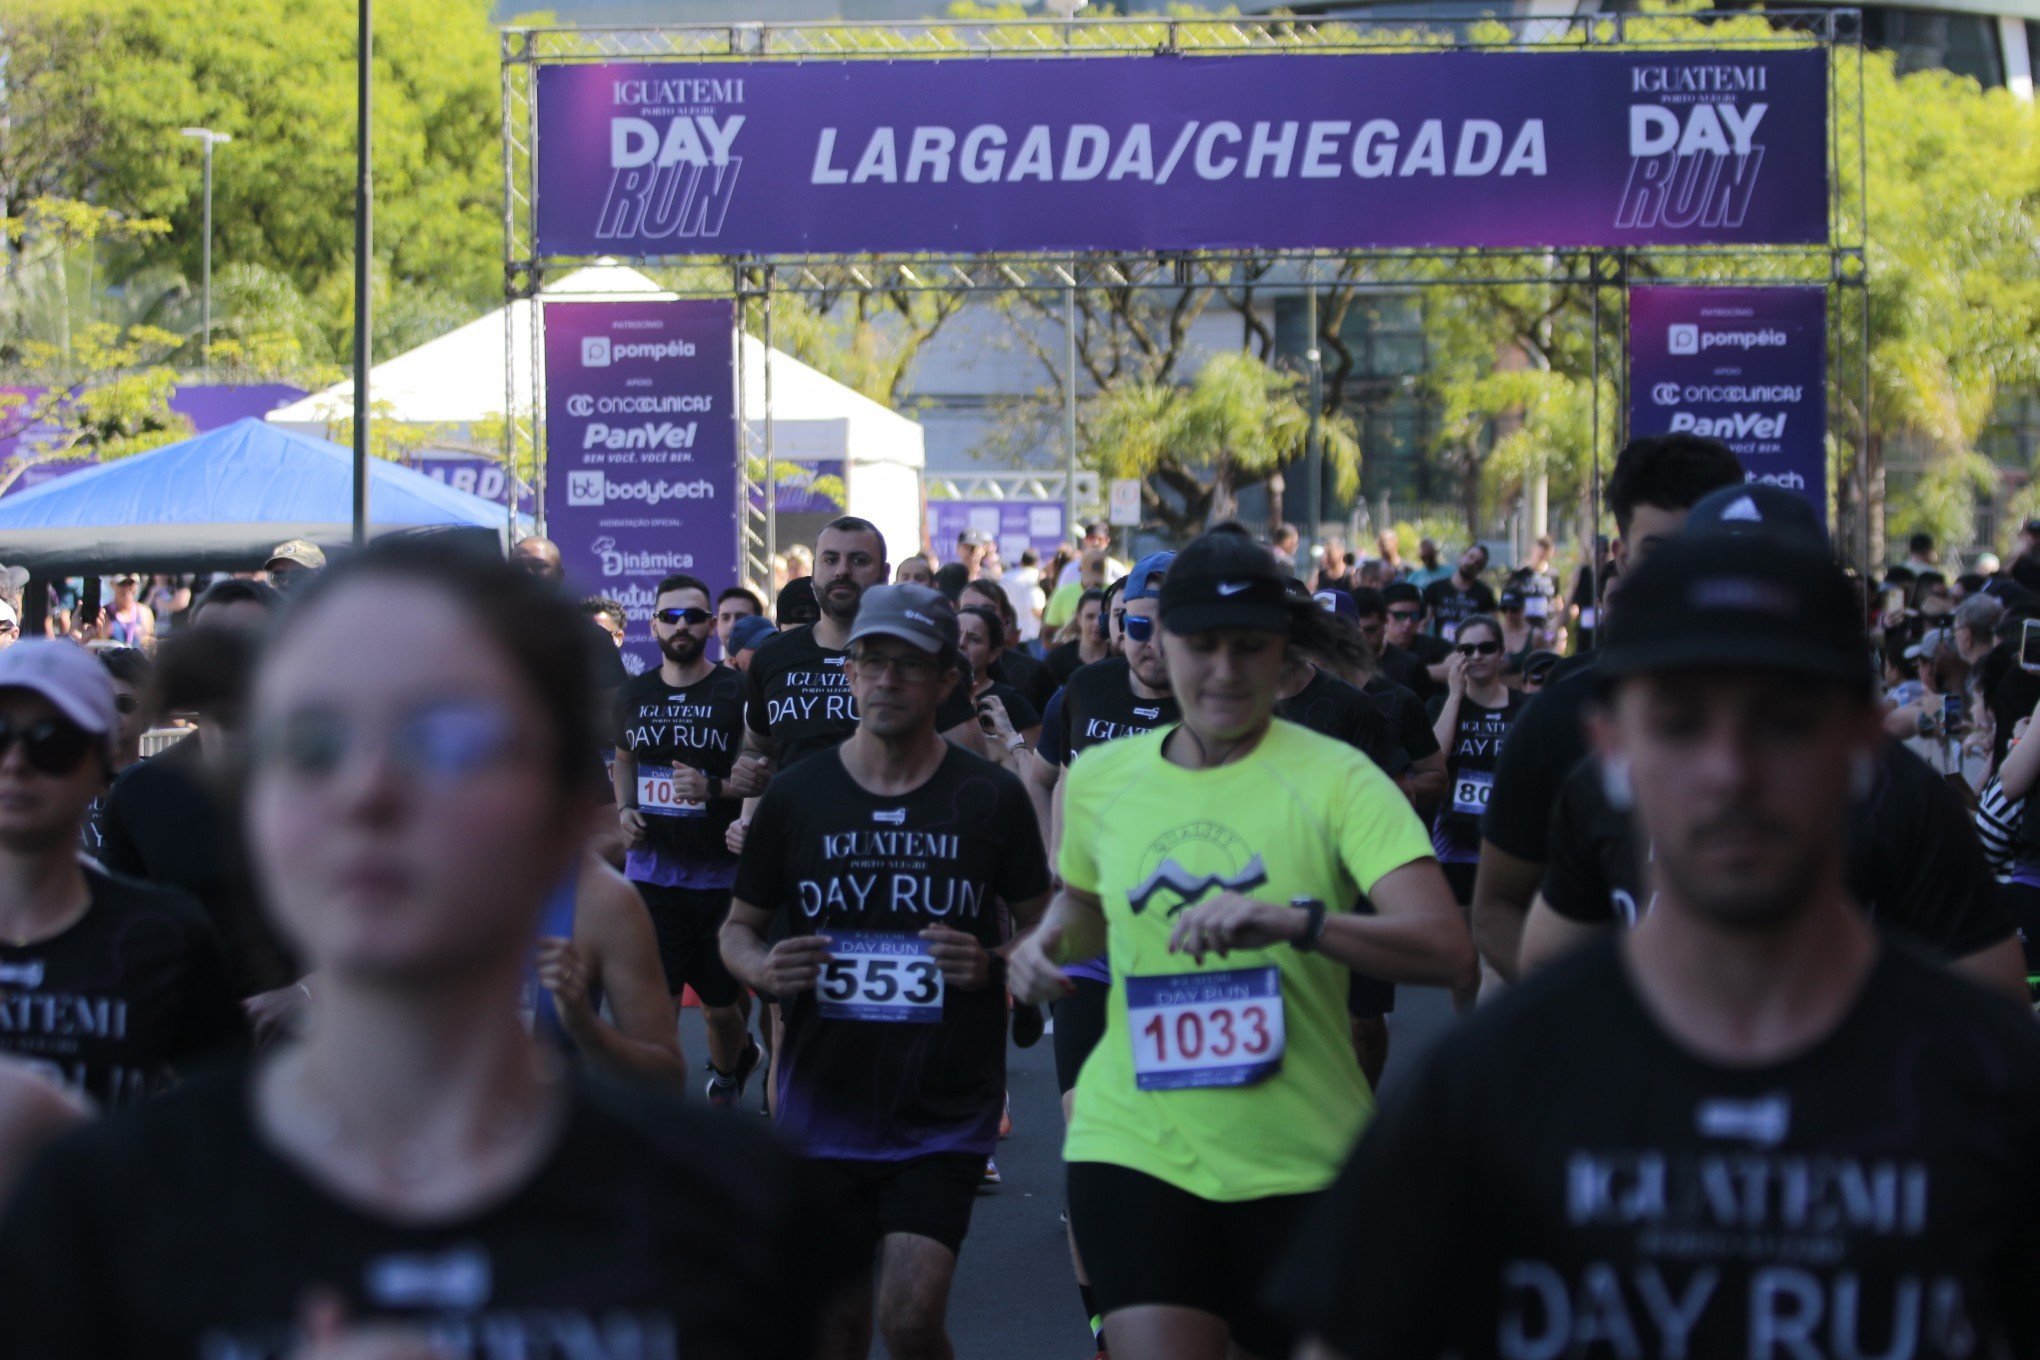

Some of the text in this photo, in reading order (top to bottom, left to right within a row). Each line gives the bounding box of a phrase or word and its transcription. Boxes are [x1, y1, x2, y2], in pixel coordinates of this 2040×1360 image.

[613, 78, 744, 105] IGUATEMI
[1632, 65, 1766, 92] IGUATEMI
[611, 115, 746, 168] DAY
[1630, 103, 1768, 157] DAY
[811, 119, 1547, 184] LARGADA/CHEGADA
[596, 156, 743, 238] RUN
[1614, 144, 1766, 228] RUN
[613, 339, 696, 362] pompéia
[1702, 328, 1787, 350] pompéia
[583, 422, 698, 449] PanVel
[583, 453, 604, 464] BEM
[605, 479, 715, 505] bodytech
[601, 549, 693, 576] Dinâmica
[786, 672, 850, 687] IGUATE
[638, 704, 713, 719] IGUATEMI
[768, 695, 862, 726] DAY RU
[626, 725, 730, 752] DAY RUN
[644, 780, 699, 807] 10
[823, 831, 960, 860] IGUATEMI
[799, 874, 985, 918] DAY RUN
[841, 941, 919, 955] DAY RUN
[823, 958, 939, 1005] 553
[1143, 1005, 1272, 1063] 1033
[1498, 1260, 1720, 1360] DAY
